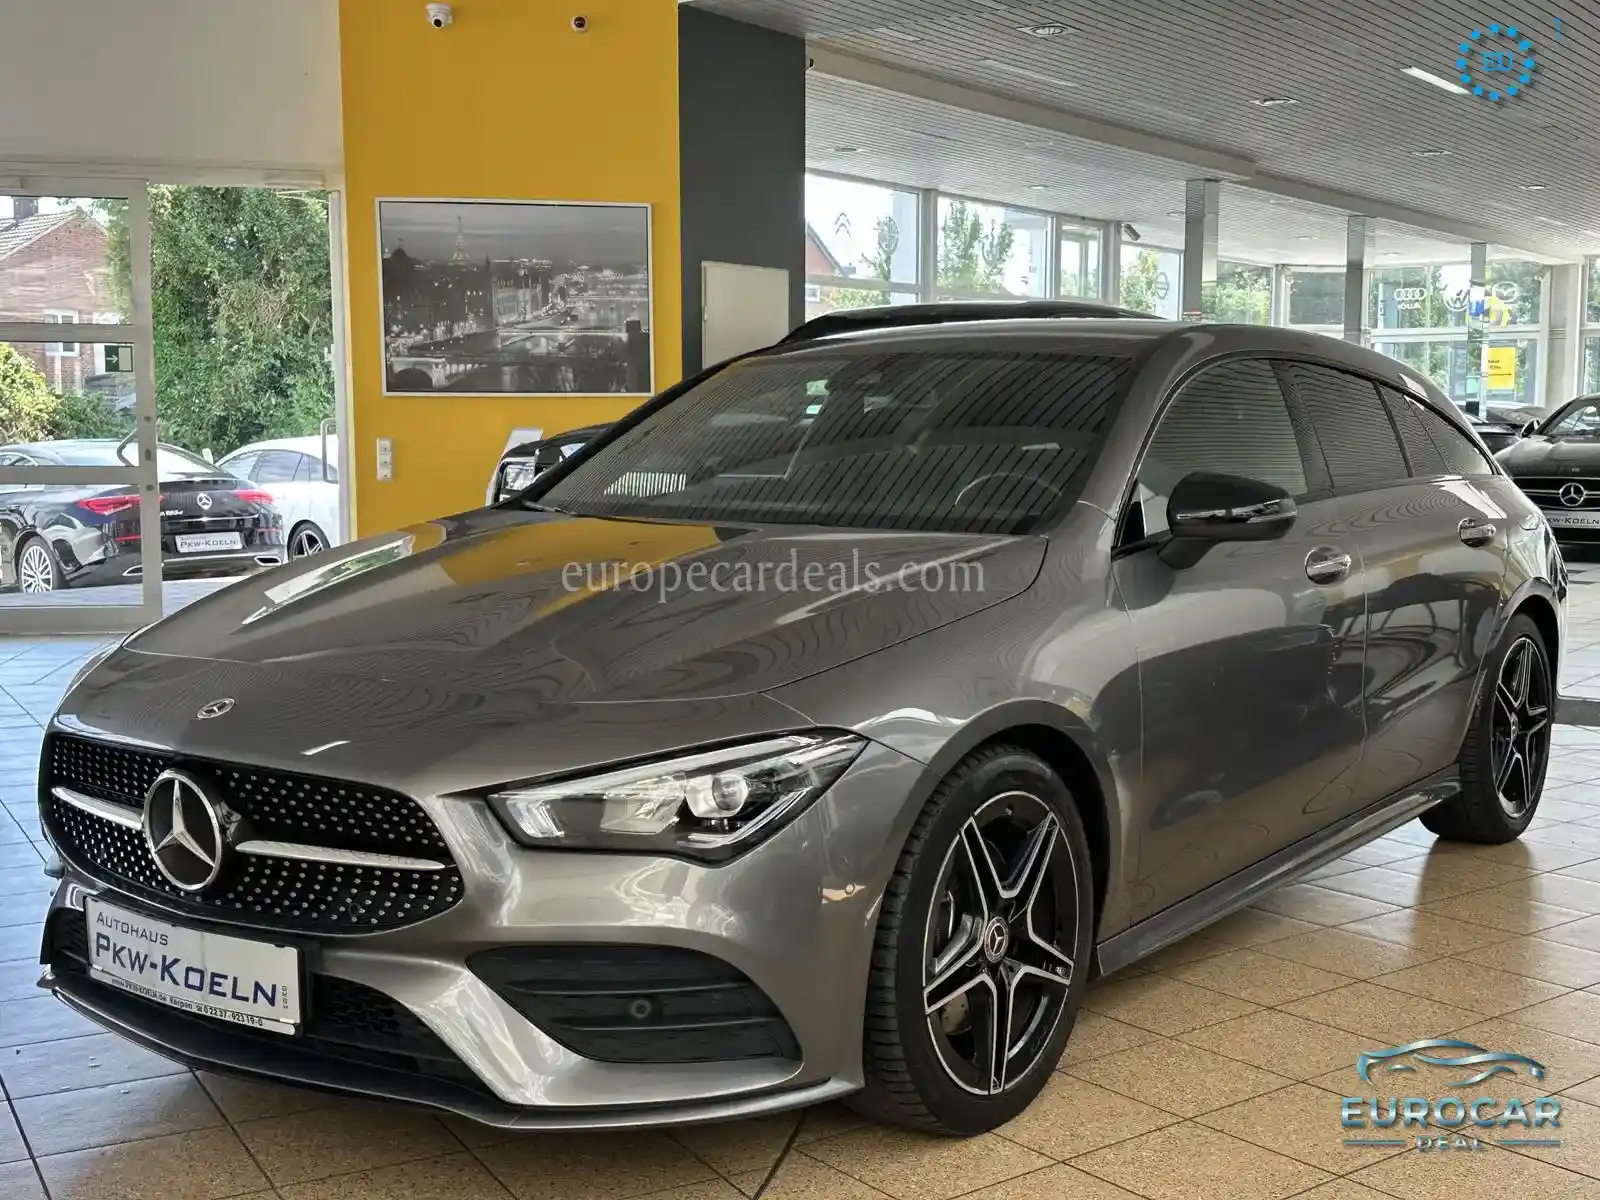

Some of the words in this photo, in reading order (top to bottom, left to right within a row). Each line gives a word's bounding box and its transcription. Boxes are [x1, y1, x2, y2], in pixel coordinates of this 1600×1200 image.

[1547, 516, 1600, 525] KW-KOELN
[96, 911, 169, 946] AUTOHAUS
[95, 931, 277, 1007] PKW-KOELN
